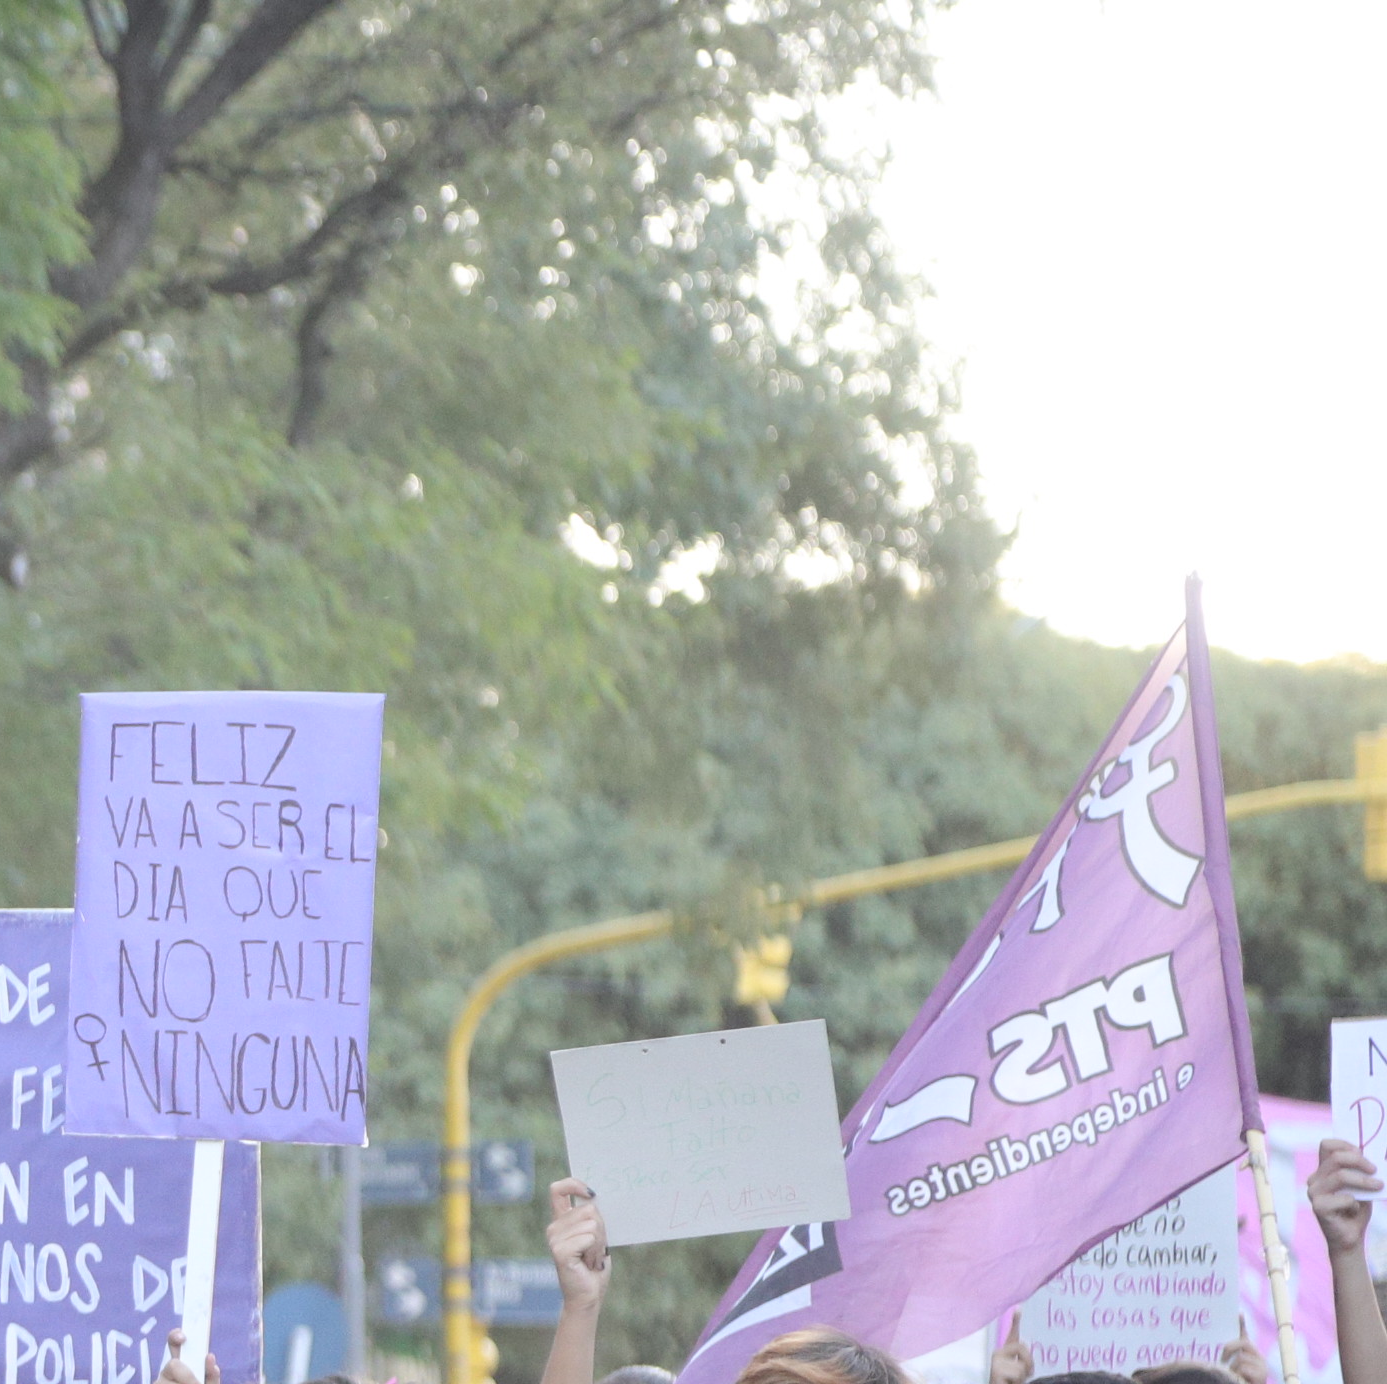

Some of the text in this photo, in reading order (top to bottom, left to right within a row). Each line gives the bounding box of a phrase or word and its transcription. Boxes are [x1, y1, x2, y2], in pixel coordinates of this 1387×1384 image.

[110, 721, 297, 791] FELIZ
[105, 796, 371, 862] VA A SER EL
[113, 860, 322, 923] DIA QUE
[118, 939, 365, 1022] NO FALTE
[121, 1029, 366, 1121] NINGUNA
[63, 1155, 135, 1227] EN
[1154, 1215, 1186, 1235] no
[1113, 1269, 1227, 1297] cambiando
[1047, 1298, 1212, 1335] las cosas que
[1067, 1340, 1127, 1372] puedo
